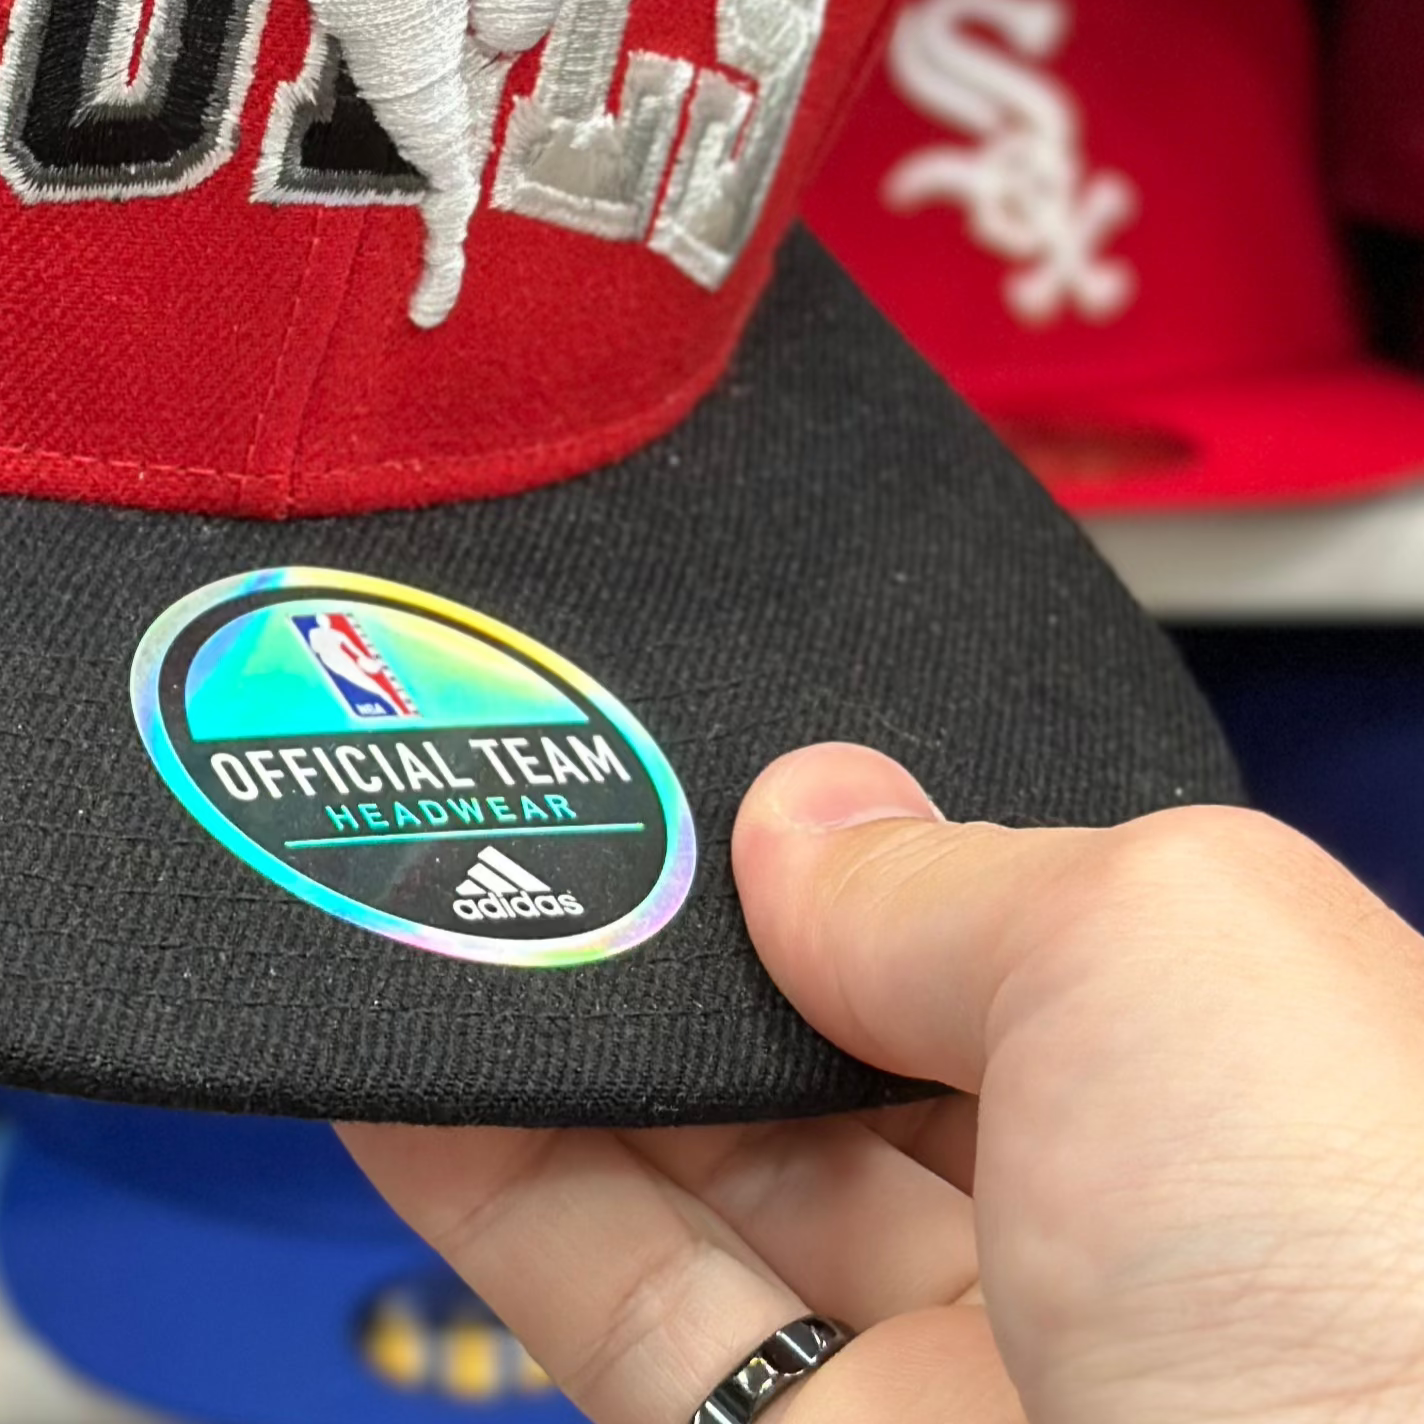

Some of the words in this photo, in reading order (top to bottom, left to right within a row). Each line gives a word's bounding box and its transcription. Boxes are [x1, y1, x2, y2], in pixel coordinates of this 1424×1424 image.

[211, 742, 474, 801] OFFICIAL
[469, 733, 632, 786] TEAM
[325, 794, 577, 831] HEADWEAR
[452, 889, 585, 921] adidas
